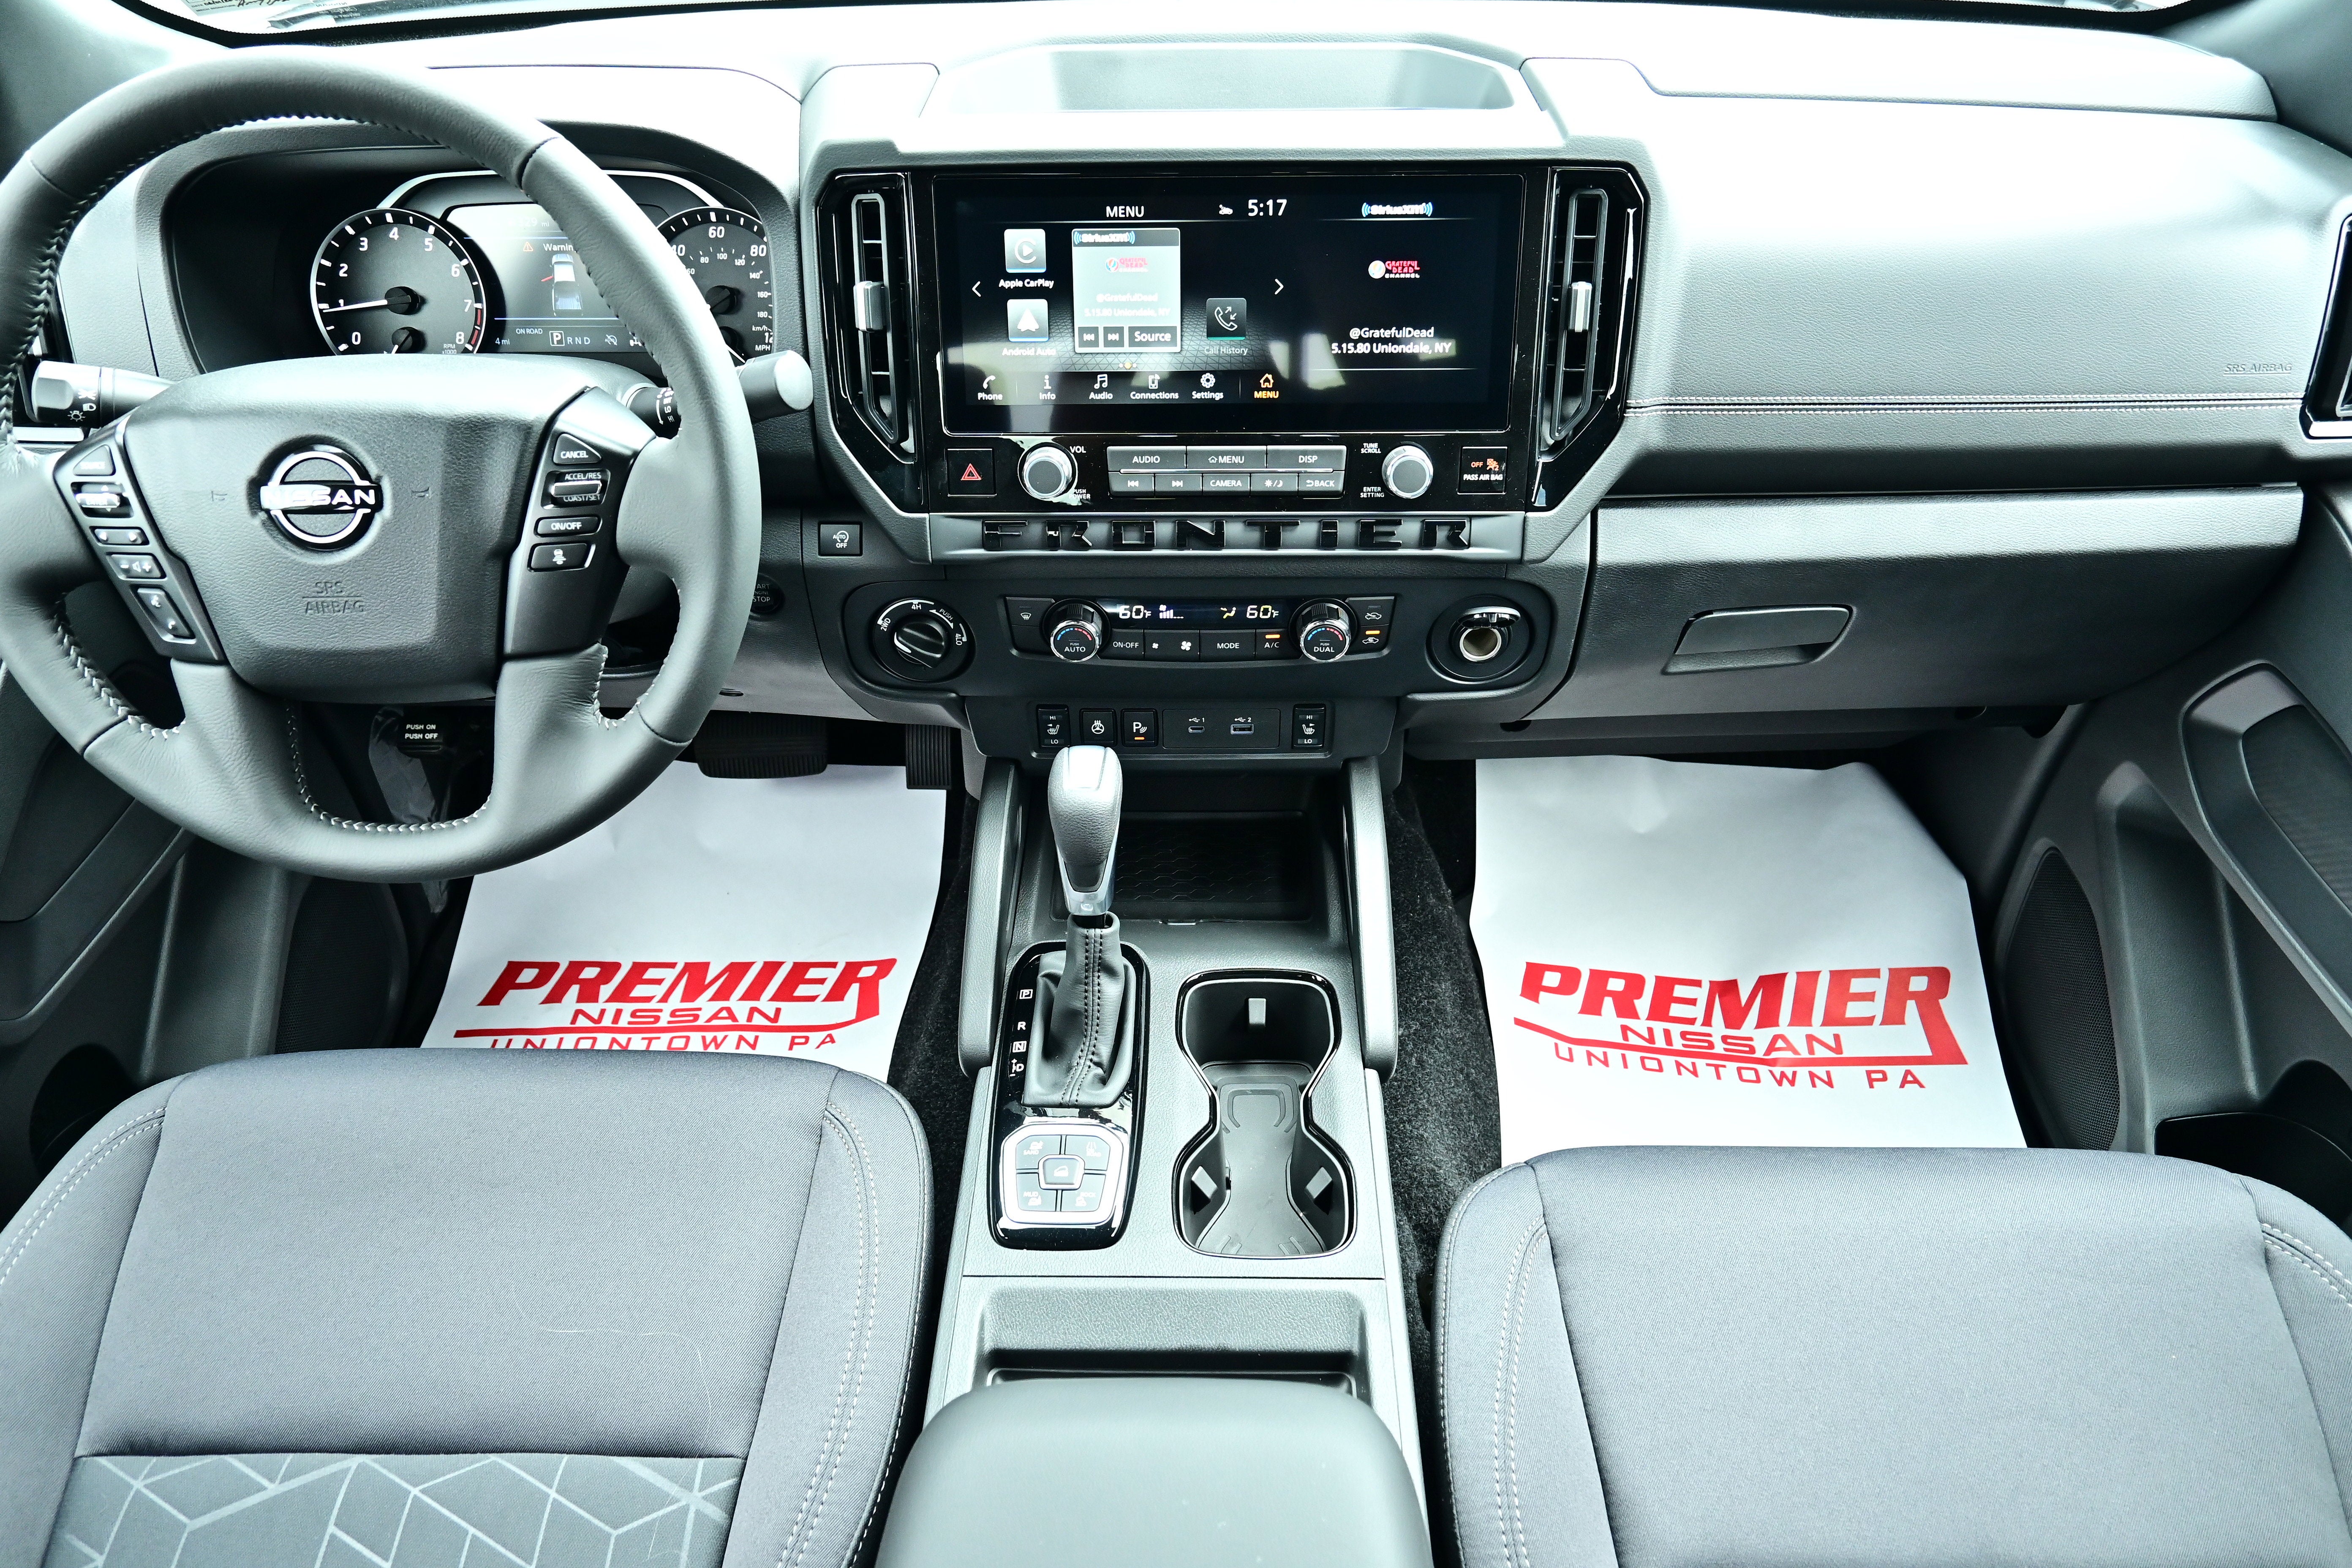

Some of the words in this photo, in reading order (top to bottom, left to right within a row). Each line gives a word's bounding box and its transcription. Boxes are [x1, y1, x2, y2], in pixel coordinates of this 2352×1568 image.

[1106, 206, 1144, 218] MENU
[1247, 199, 1288, 216] 5:17
[389, 227, 399, 240] 4
[708, 226, 725, 238] 60
[359, 237, 368, 251] 3
[425, 237, 433, 251] 5
[750, 245, 767, 256] 80
[339, 264, 348, 277] 2
[451, 264, 460, 277] 6
[1385, 261, 1420, 270] GRATEFUL
[999, 279, 1023, 289] Apple
[1024, 278, 1054, 289] CarPlay
[464, 299, 472, 312] 7
[351, 332, 361, 345] 0
[455, 332, 465, 344] 8
[1134, 331, 1171, 342] Source
[1349, 327, 1435, 339] @GratefulDead
[1002, 348, 1035, 356] Android
[1036, 348, 1056, 356] Auto
[1220, 346, 1248, 356] History
[1331, 343, 1371, 354] 5.15.80
[1372, 342, 1432, 355] Uniondale,
[1434, 342, 1452, 353] NY
[2225, 364, 2246, 373] SRS
[2250, 363, 2292, 373] AIRBAG
[977, 392, 1003, 401] Phone
[1089, 392, 1113, 400] Audio
[1130, 391, 1179, 400] Connections
[1192, 391, 1224, 401] Settings
[1254, 390, 1279, 398] MENU
[560, 450, 588, 458] CANCEL
[1132, 455, 1160, 464] AUDIO
[1218, 455, 1244, 464] MENU
[1298, 455, 1318, 463] DISP
[564, 472, 602, 481] ACCEL/RES
[1210, 479, 1242, 487] CAMERA
[1314, 479, 1335, 487] BACK
[551, 522, 583, 530] ON/OFF
[982, 519, 1470, 549] FRONTIER
[304, 600, 365, 615] AIRBAG
[939, 608, 954, 621] PUSH
[880, 618, 891, 632] 2WD
[476, 958, 897, 1014] PREMIER
[1022, 990, 1030, 999] P
[1519, 961, 1960, 1043] PREMIER
[570, 1007, 781, 1025] NISSAN
[1018, 1021, 1026, 1030] R
[788, 1034, 836, 1051] PA
[1621, 1024, 1843, 1056] NISSAN
[1015, 1042, 1024, 1051] N
[1016, 1063, 1024, 1072] D
[1554, 1042, 1834, 1089] UNIONTOWN
[1866, 1069, 1926, 1089] PA
